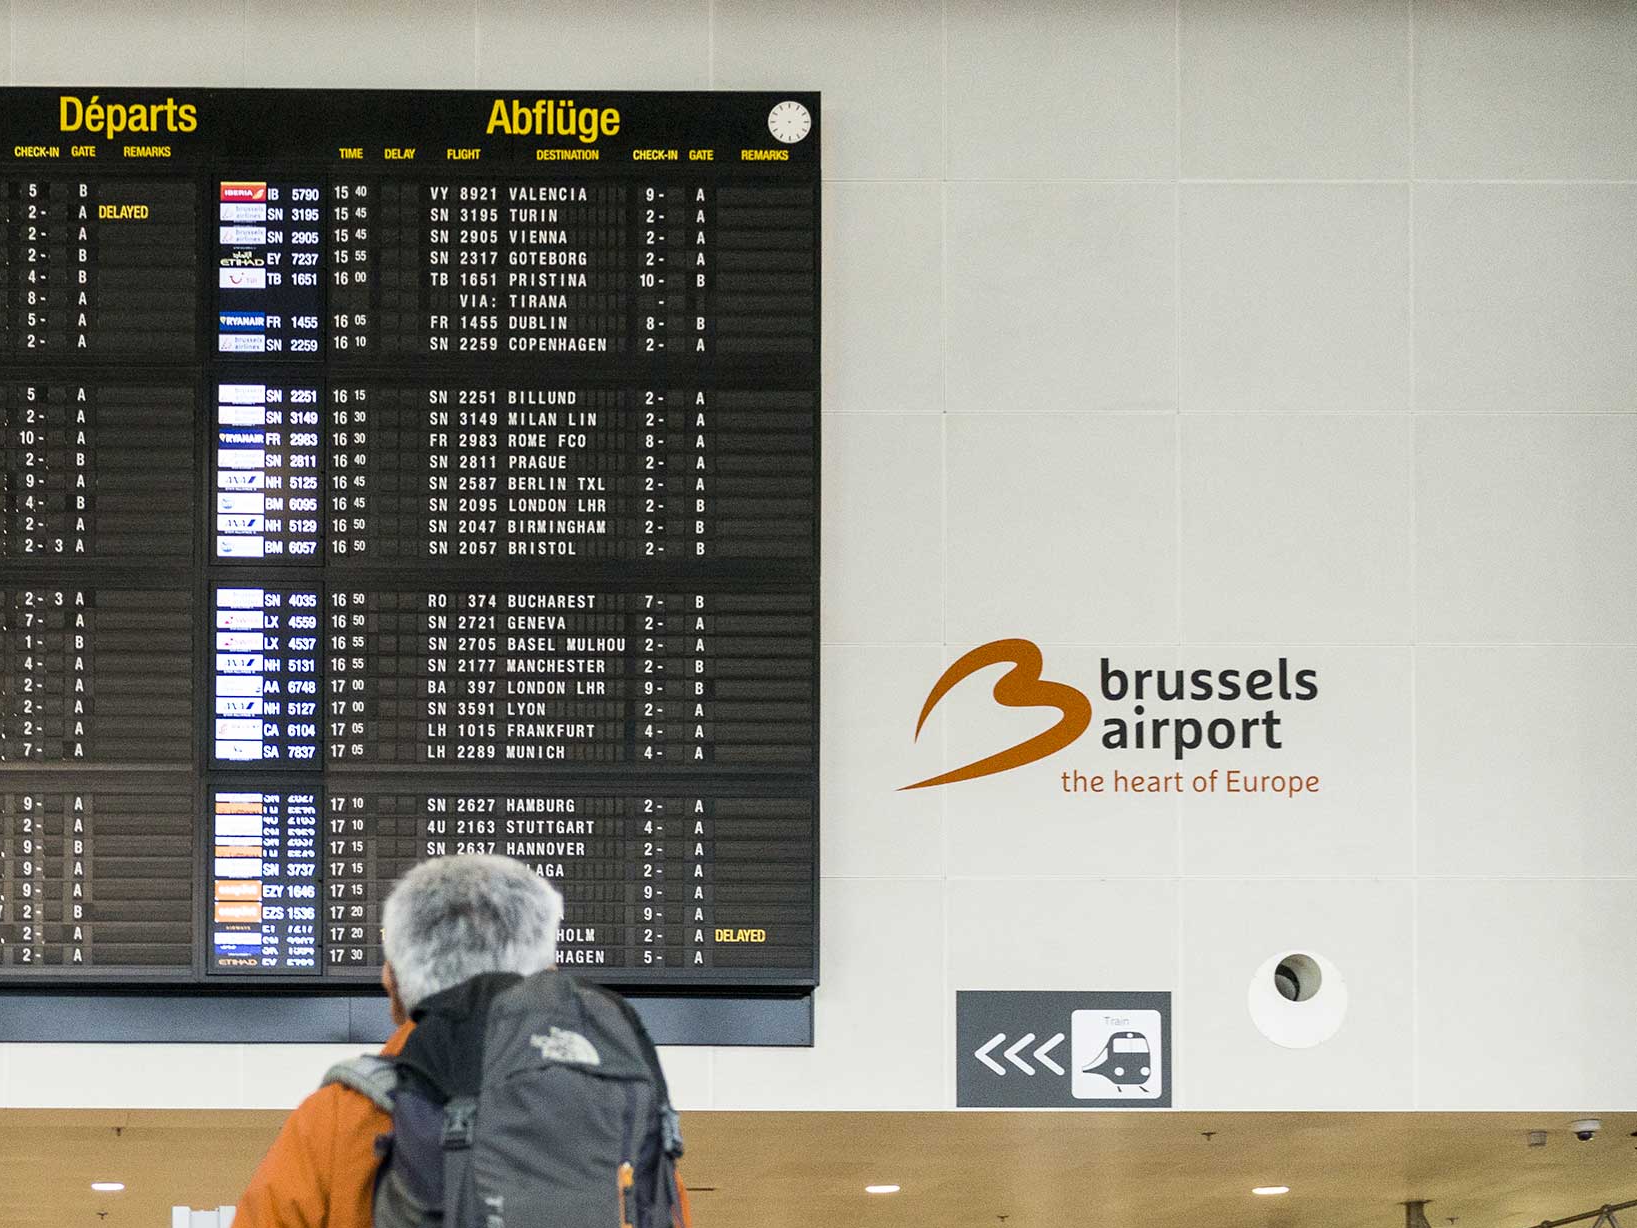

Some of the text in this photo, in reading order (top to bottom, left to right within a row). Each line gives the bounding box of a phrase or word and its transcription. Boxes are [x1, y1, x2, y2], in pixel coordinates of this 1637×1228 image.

[60, 96, 198, 139] Départs
[486, 99, 620, 144] Abflüge
[14, 146, 60, 158] CHECK-IN
[71, 145, 96, 157] GATE
[123, 146, 172, 158] REMARKS
[338, 148, 789, 161] TIME DELAY FLIGHT DESTINATION CHECK-IN GATE REMARKS
[509, 187, 587, 201] VALENCIA
[98, 205, 149, 219] DELAYED
[509, 208, 558, 223] TURIN
[508, 230, 567, 244] VIENNA
[509, 251, 587, 266] GOTEBORG
[509, 272, 587, 287] PRISTINA
[509, 294, 567, 309] TIRANA
[226, 316, 265, 326] RYANAIR
[509, 315, 567, 330] DUBLIN
[508, 390, 576, 405] BILLUND
[508, 412, 597, 426] MILAN LIN
[509, 455, 566, 469] PRAGUE
[508, 476, 606, 491] BERLIN TXL
[508, 541, 576, 555] BRISTOL
[507, 594, 596, 609] BUCHAREST
[507, 615, 566, 630] GENEVA
[507, 637, 626, 652] BASEL MULHOU
[506, 659, 605, 673] MANCHESTER
[1100, 657, 1319, 701] brussels
[507, 680, 605, 695] LONDON LHR
[507, 702, 546, 716] LYON
[1101, 704, 1283, 760] airport
[1061, 769, 1320, 798] the heart of Europe
[506, 798, 575, 813] HAMBURG
[506, 820, 595, 834] STUTTGART
[506, 842, 585, 856] HANNOVER
[715, 928, 766, 943] DELAYED
[1103, 1015, 1130, 1026] Train
